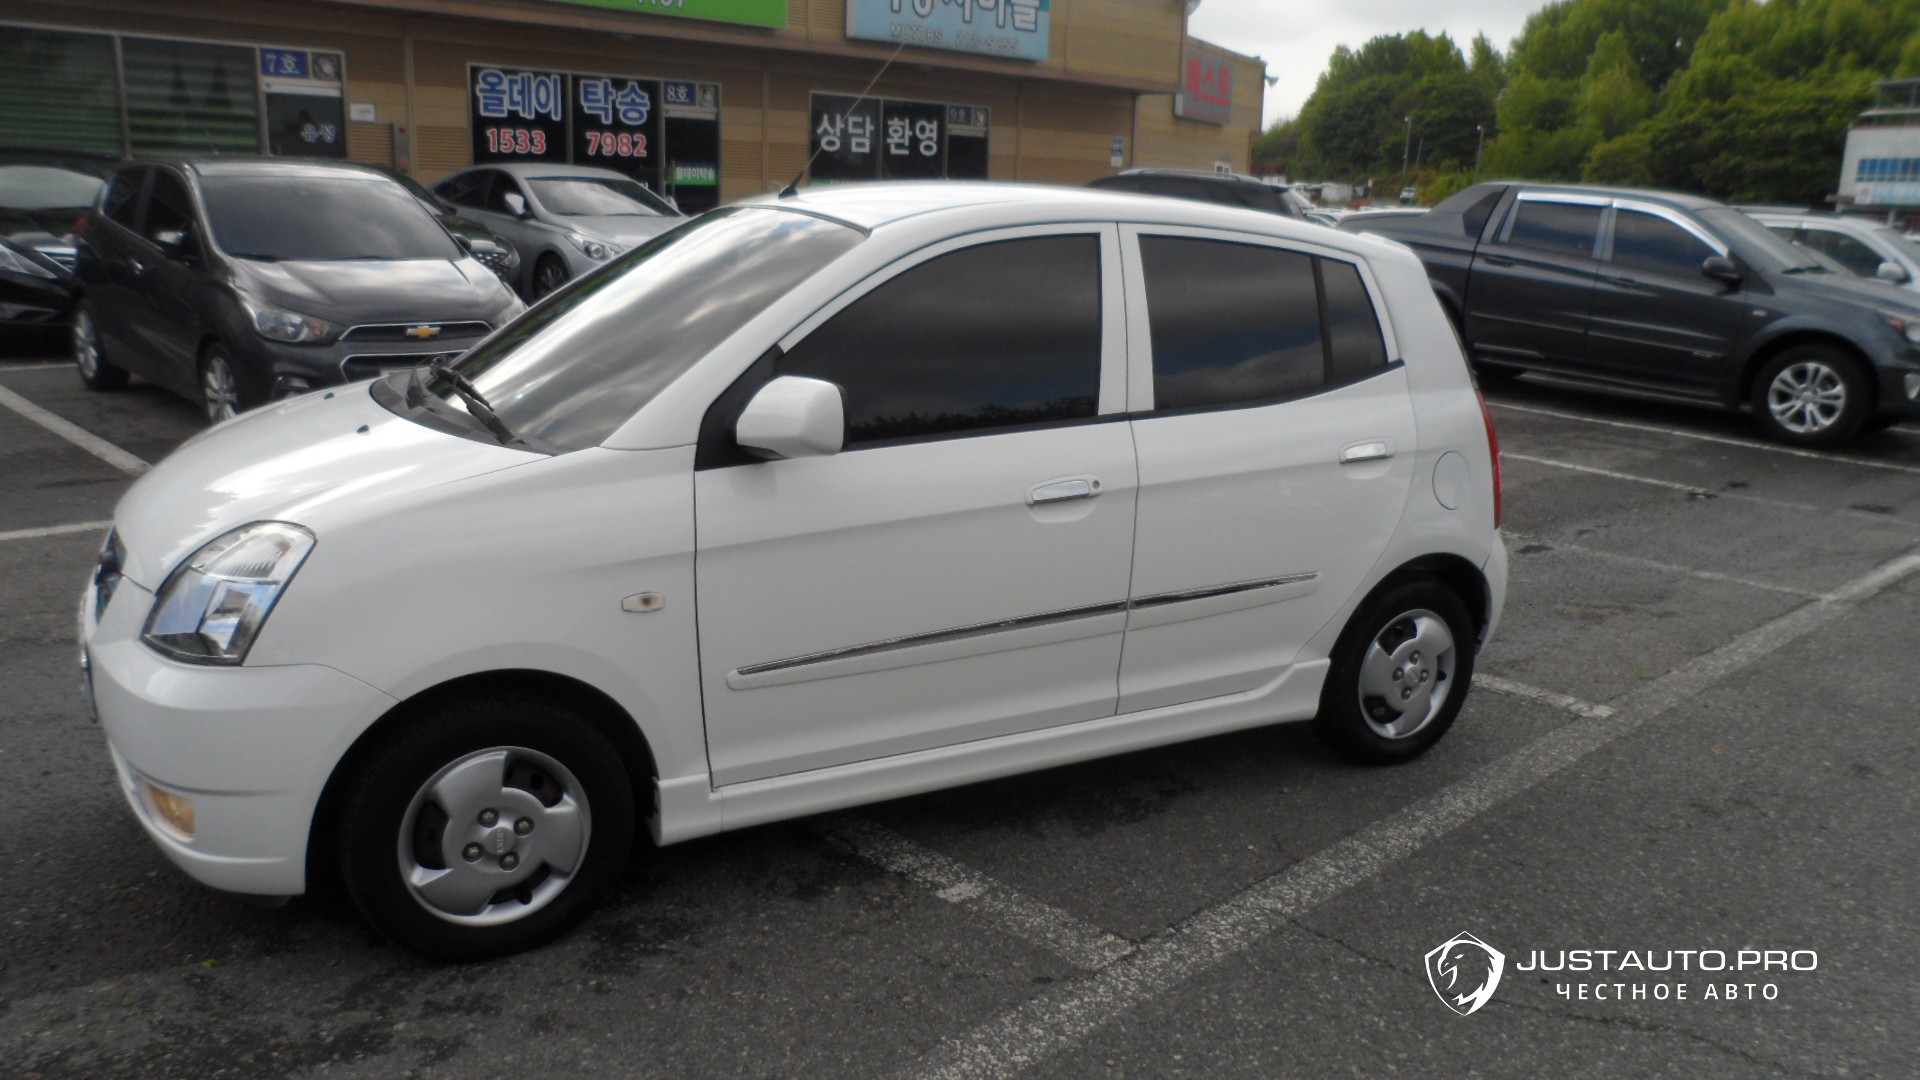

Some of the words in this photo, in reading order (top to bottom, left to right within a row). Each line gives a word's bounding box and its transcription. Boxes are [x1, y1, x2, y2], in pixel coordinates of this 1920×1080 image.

[891, 24, 943, 43] MOTORS
[264, 53, 301, 75] 7호
[476, 69, 561, 121] 올데이
[580, 78, 650, 125] 탁송
[667, 85, 690, 103] 8호
[486, 128, 546, 154] 1533
[586, 131, 647, 157] 7982
[816, 114, 874, 153] 상담
[887, 117, 938, 157] 환영
